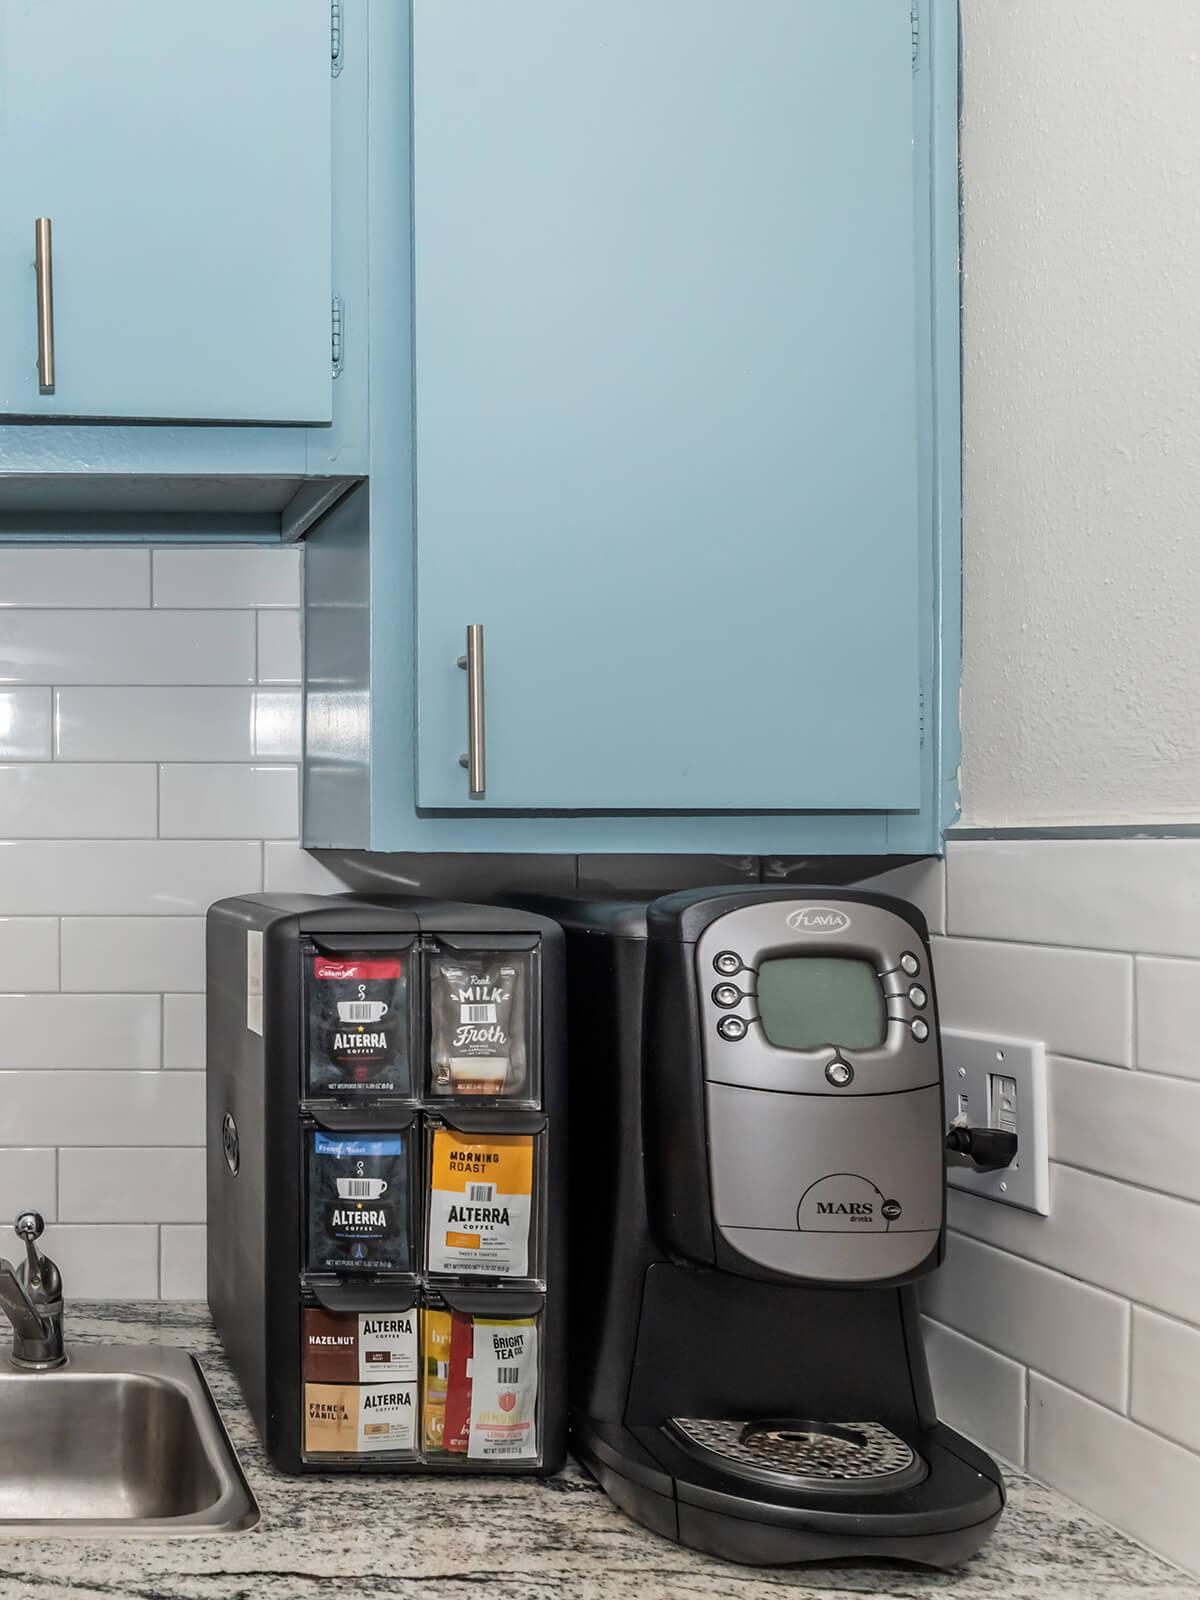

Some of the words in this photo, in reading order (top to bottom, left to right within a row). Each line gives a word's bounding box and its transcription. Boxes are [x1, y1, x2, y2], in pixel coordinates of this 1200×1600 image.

[458, 986, 503, 1003] MILK
[333, 1032, 387, 1050] ALTERRA
[452, 1025, 507, 1046] Froth
[450, 1151, 500, 1163] MORNING
[449, 1161, 487, 1173] ROAST
[447, 1205, 510, 1226] ALTERRA
[816, 1202, 873, 1215] MARS
[332, 1209, 386, 1227] ALTERRA
[363, 1319, 413, 1335] ALTERRA
[309, 1336, 354, 1345] HAZELNUT
[493, 1334, 524, 1349] BRIGHT
[494, 1348, 514, 1360] TEA
[309, 1403, 345, 1412] FRENCH
[363, 1392, 412, 1410] ALTERRA
[309, 1411, 349, 1420] VANILA
